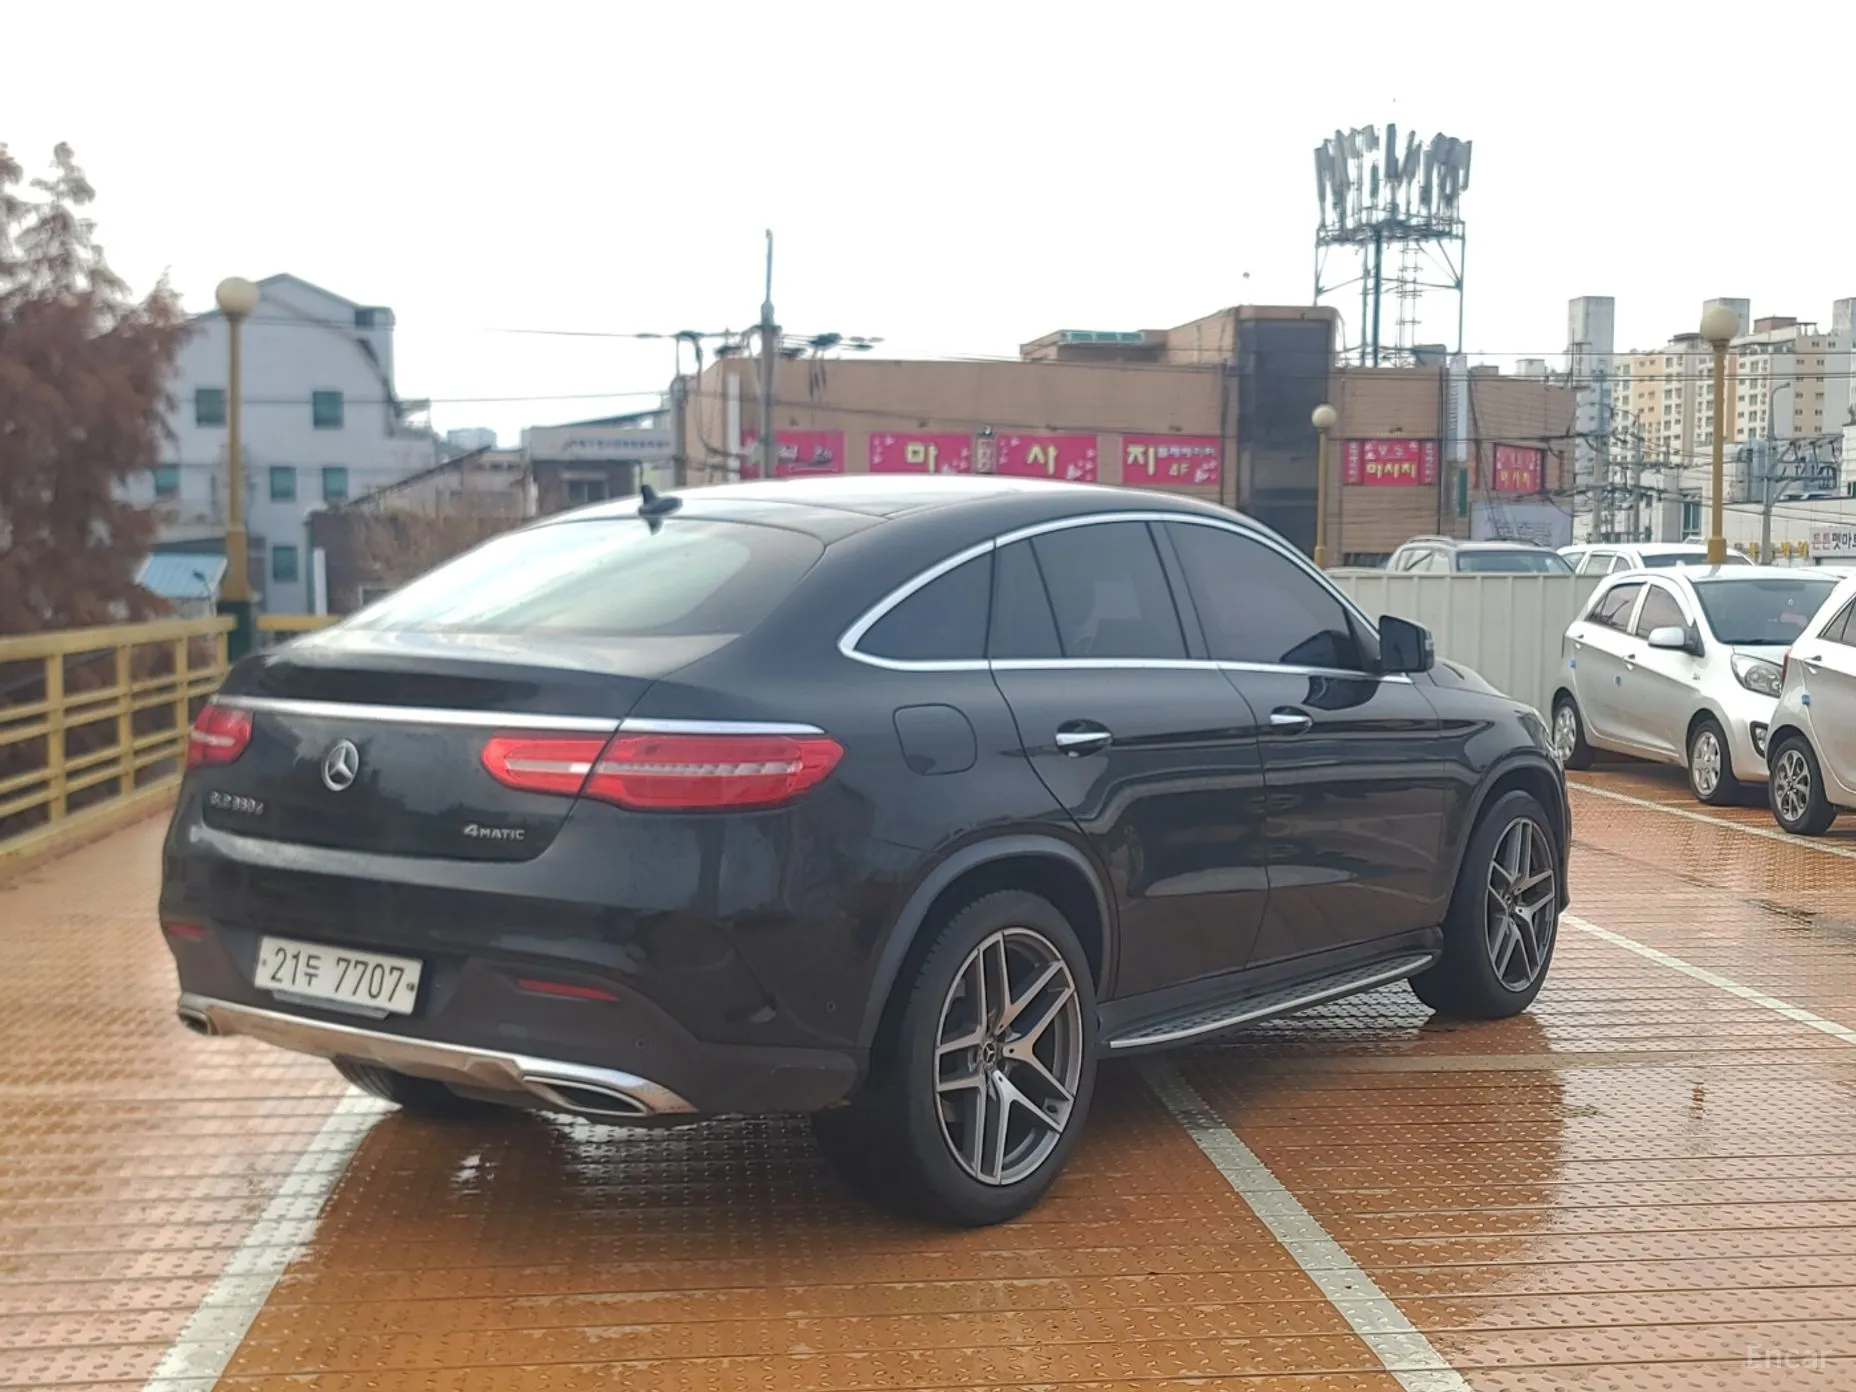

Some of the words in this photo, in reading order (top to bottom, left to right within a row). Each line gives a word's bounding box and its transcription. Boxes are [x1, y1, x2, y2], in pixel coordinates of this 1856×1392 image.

[905, 441, 939, 474] 마
[1025, 445, 1059, 476] 사
[1126, 444, 1155, 476] 지
[463, 823, 526, 841] 4MATIC
[270, 947, 322, 987] 21두
[334, 956, 406, 1003] 7707
